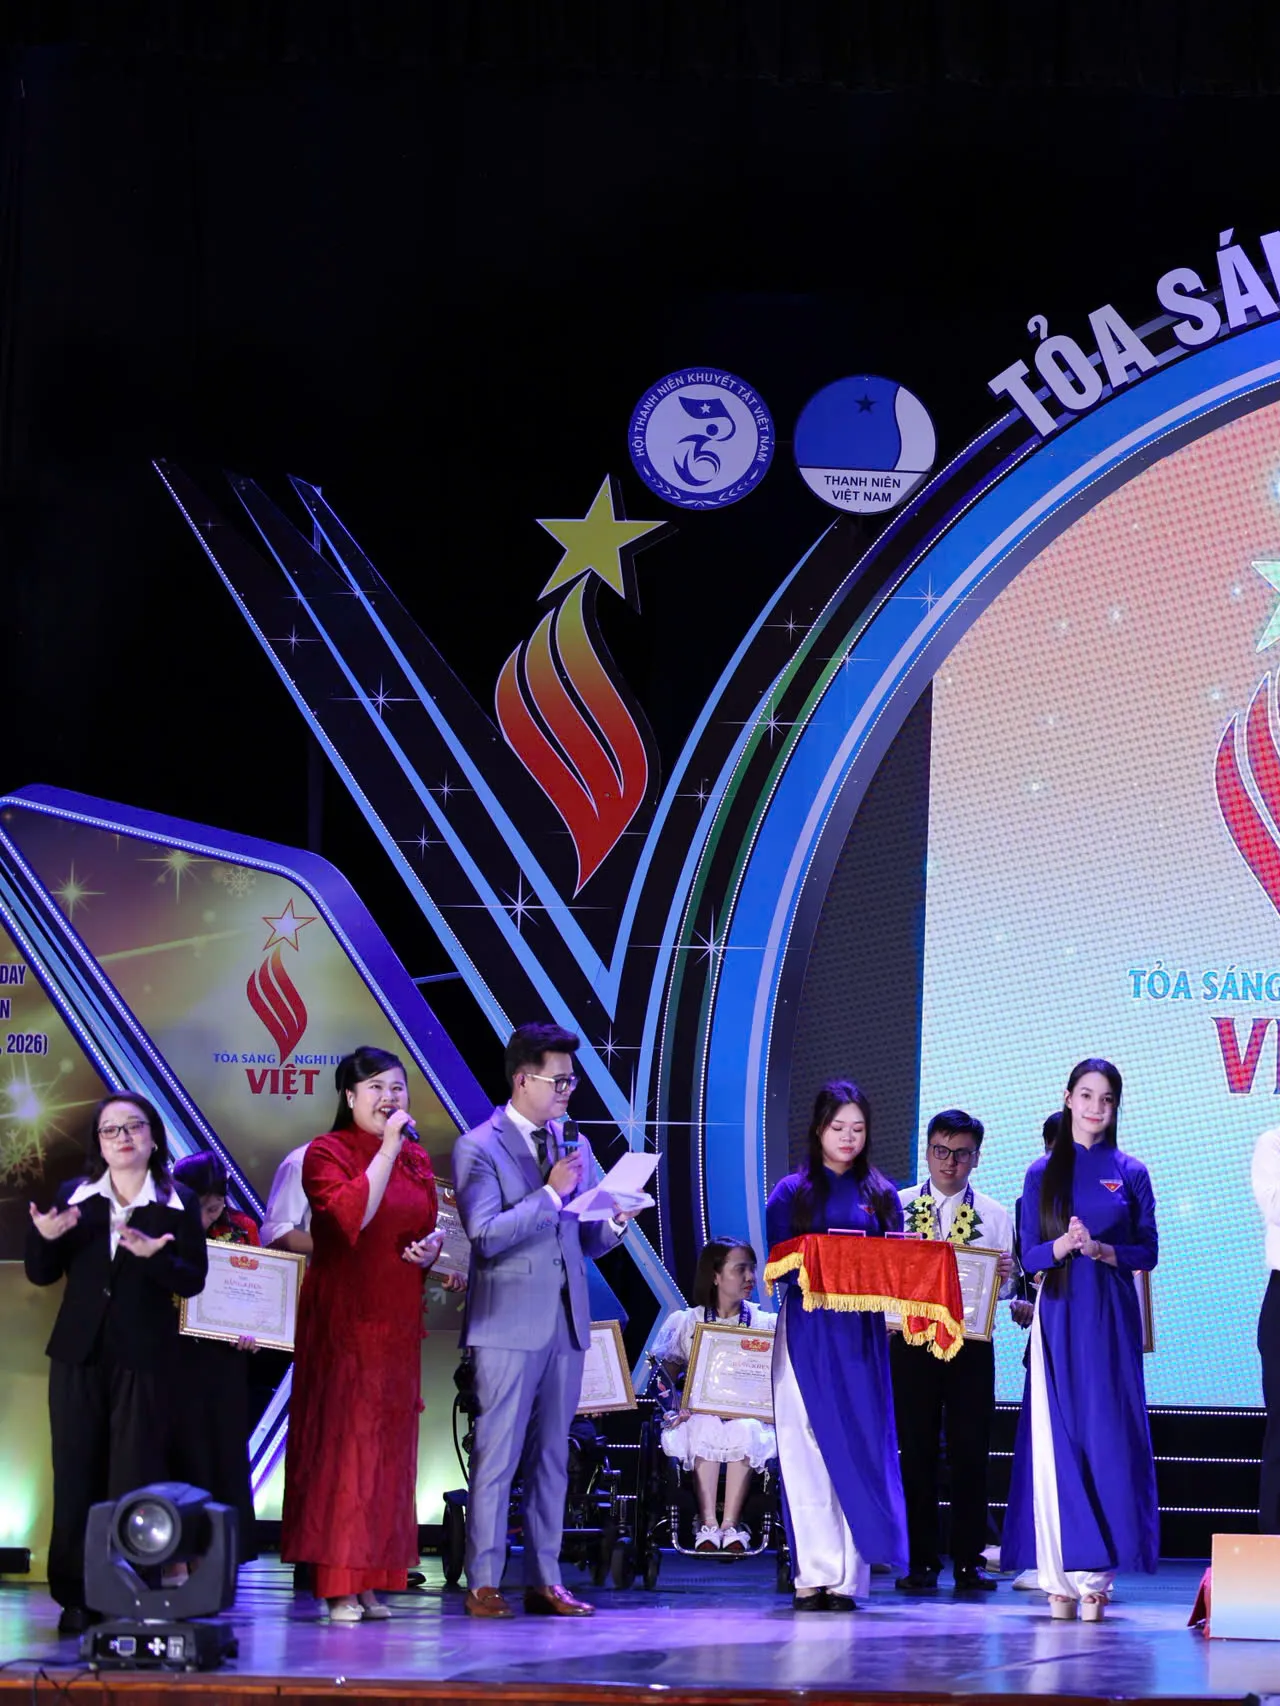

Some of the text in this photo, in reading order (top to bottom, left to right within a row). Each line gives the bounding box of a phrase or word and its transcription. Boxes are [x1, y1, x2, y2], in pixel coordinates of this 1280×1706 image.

[987, 313, 1159, 437] TỎA
[632, 372, 770, 462] HỘI THANH NIÊN KHUYẾT TẬT VIỆT NAM
[824, 475, 901, 489] THANH NIÊN
[832, 488, 892, 503] VIỆT NAM
[0, 965, 26, 985] DAY
[1128, 960, 1194, 1000] TỎA
[7, 1033, 48, 1055] 2026)
[245, 1063, 321, 1101] VIỆT
